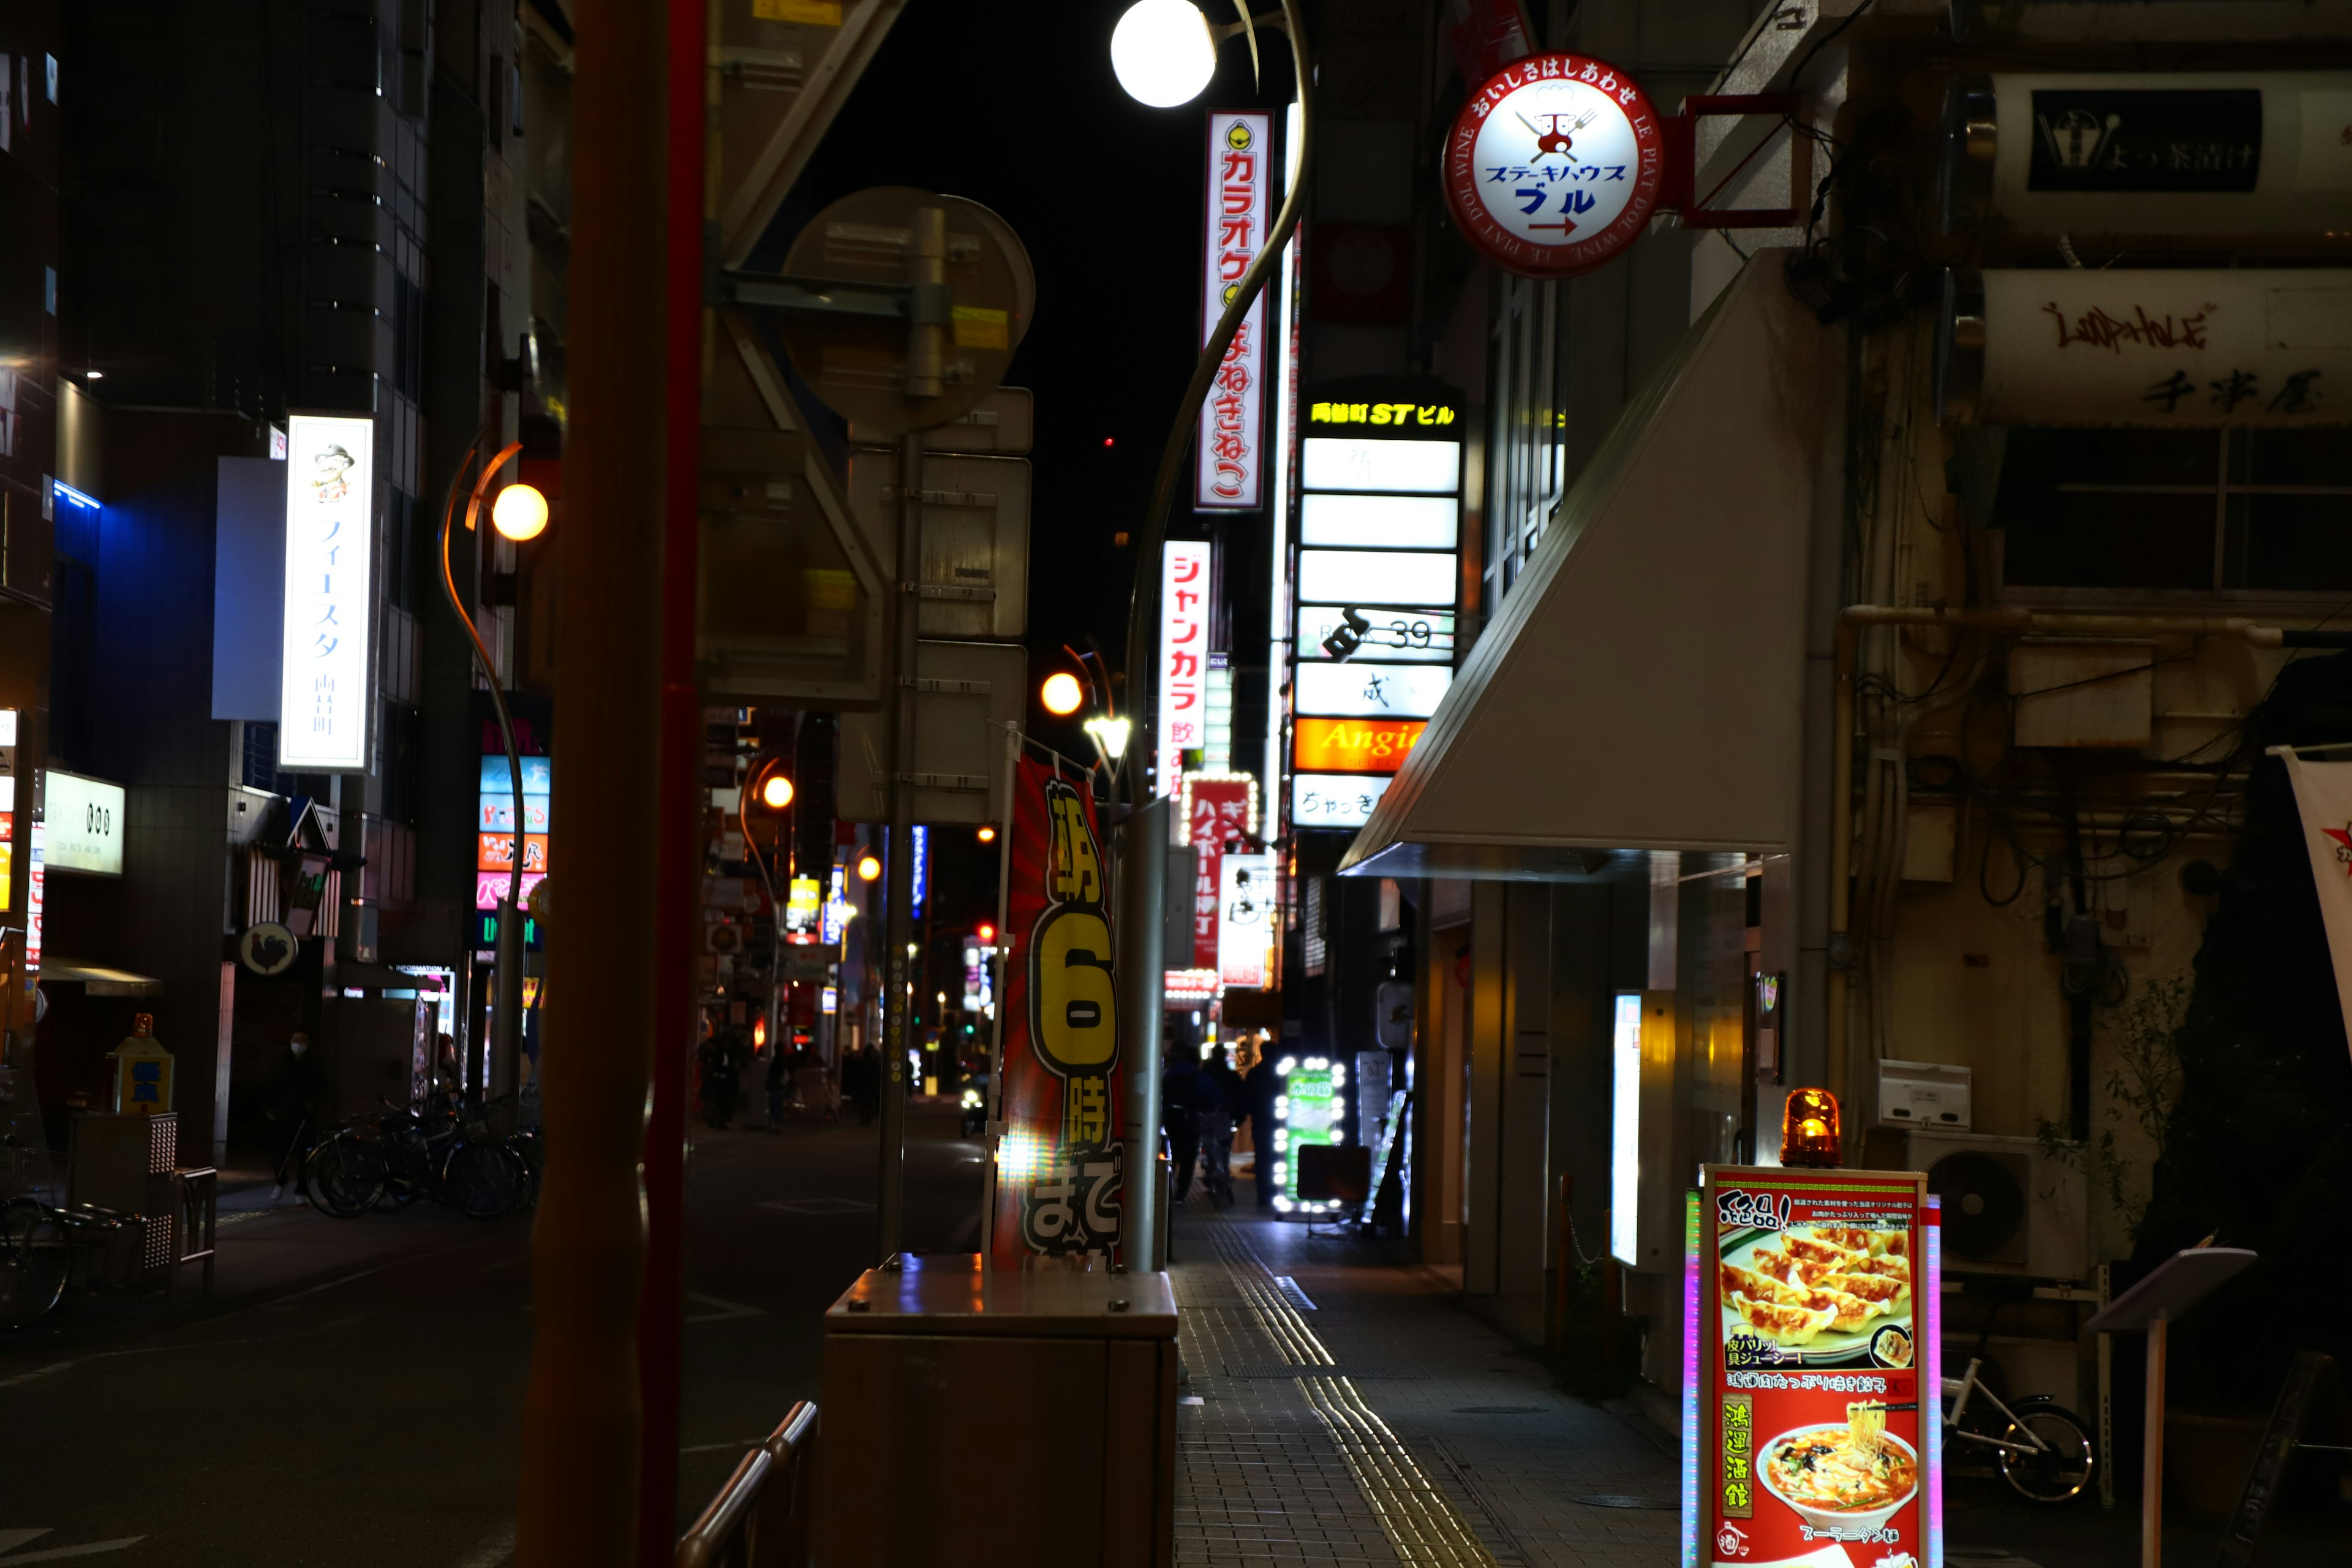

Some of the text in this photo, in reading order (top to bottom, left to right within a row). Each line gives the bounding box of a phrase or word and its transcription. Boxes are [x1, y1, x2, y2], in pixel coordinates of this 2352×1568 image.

[1471, 58, 1637, 118] おいしさはしあわせ
[1455, 126, 1475, 178] WINE
[1486, 165, 1627, 184] ステーキハウス
[1219, 151, 1256, 281] カラオケ
[1515, 183, 1597, 215] ブル
[314, 519, 341, 658] フィエスタ
[1170, 554, 1200, 710] ジャンカラ
[1390, 621, 1431, 649] 39
[1799, 1525, 1900, 1544] スーラータン麺
